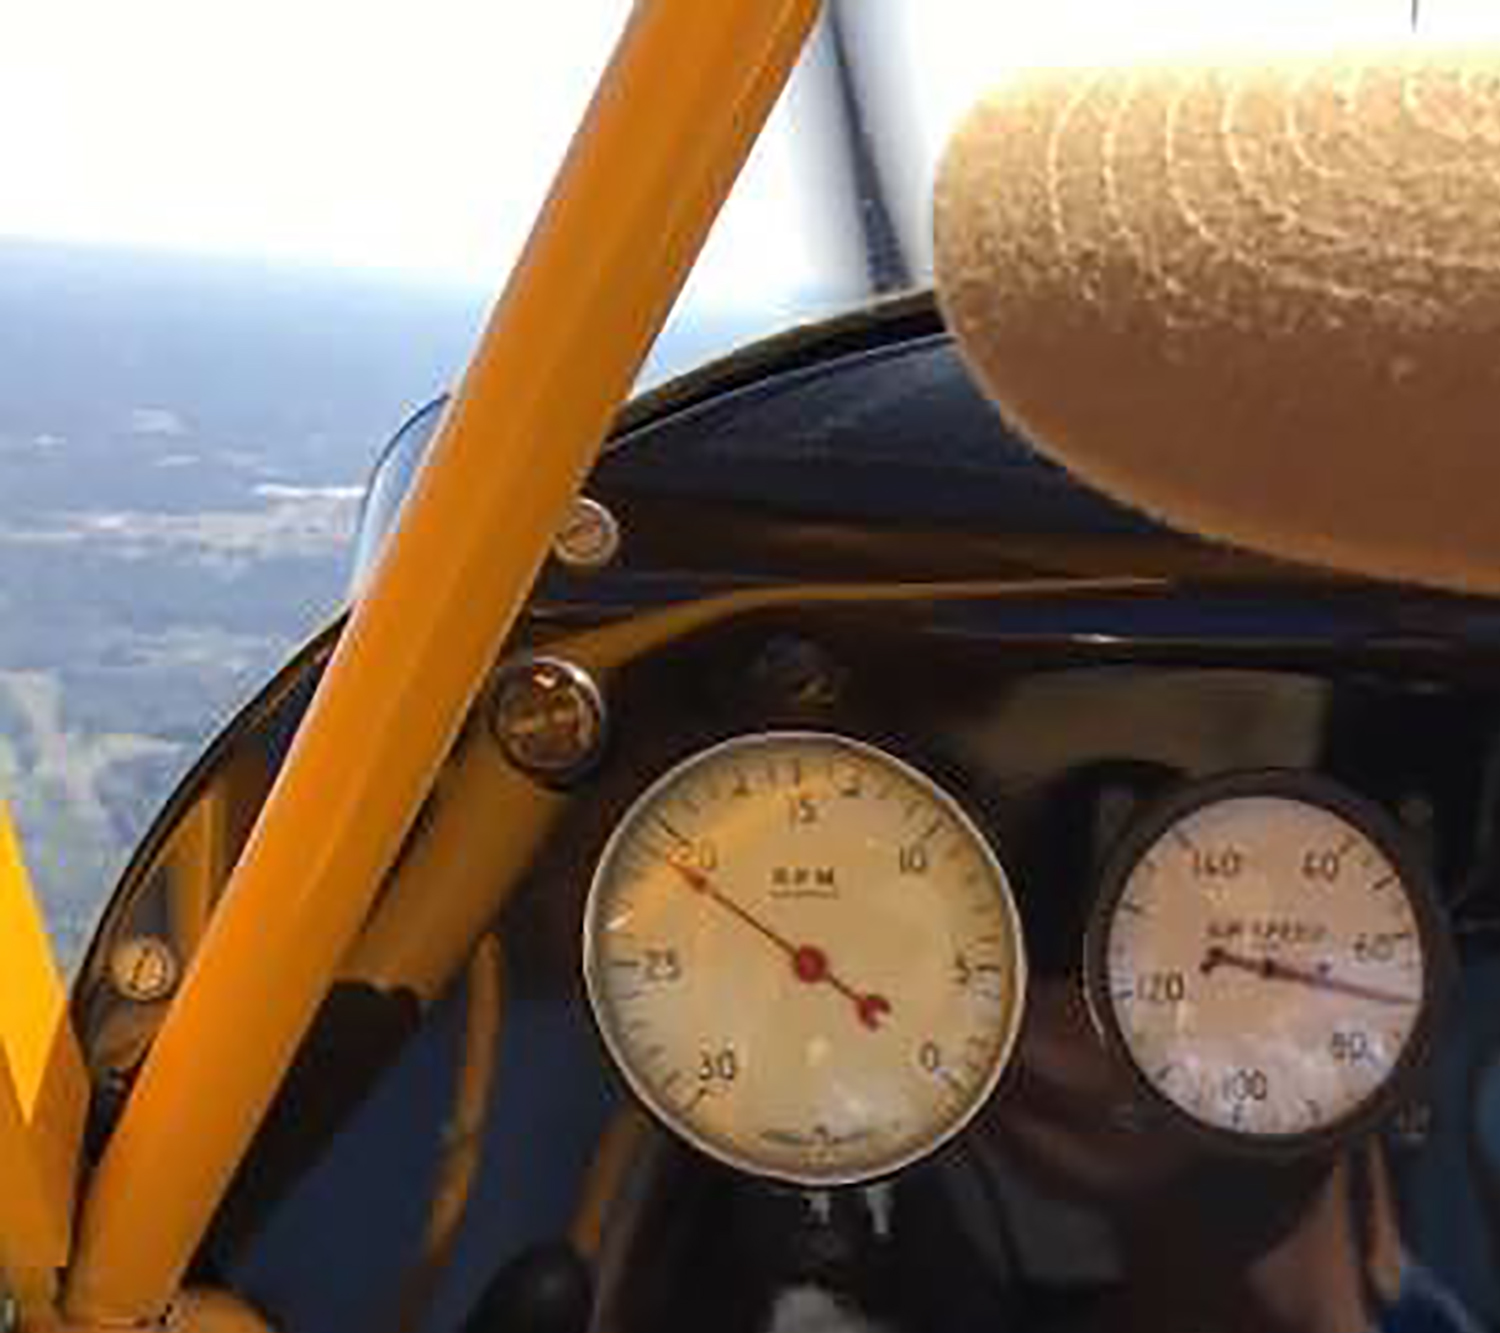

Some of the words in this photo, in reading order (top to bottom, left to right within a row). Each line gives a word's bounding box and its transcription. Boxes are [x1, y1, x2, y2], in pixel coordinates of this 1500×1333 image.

[788, 799, 818, 831] 15
[899, 845, 926, 874] 10
[1191, 850, 1242, 879] 140
[644, 949, 679, 981] 25
[1138, 972, 1184, 1000] 120
[699, 1050, 737, 1082] 30
[919, 1041, 940, 1071] 0
[1223, 1070, 1267, 1100] 100
